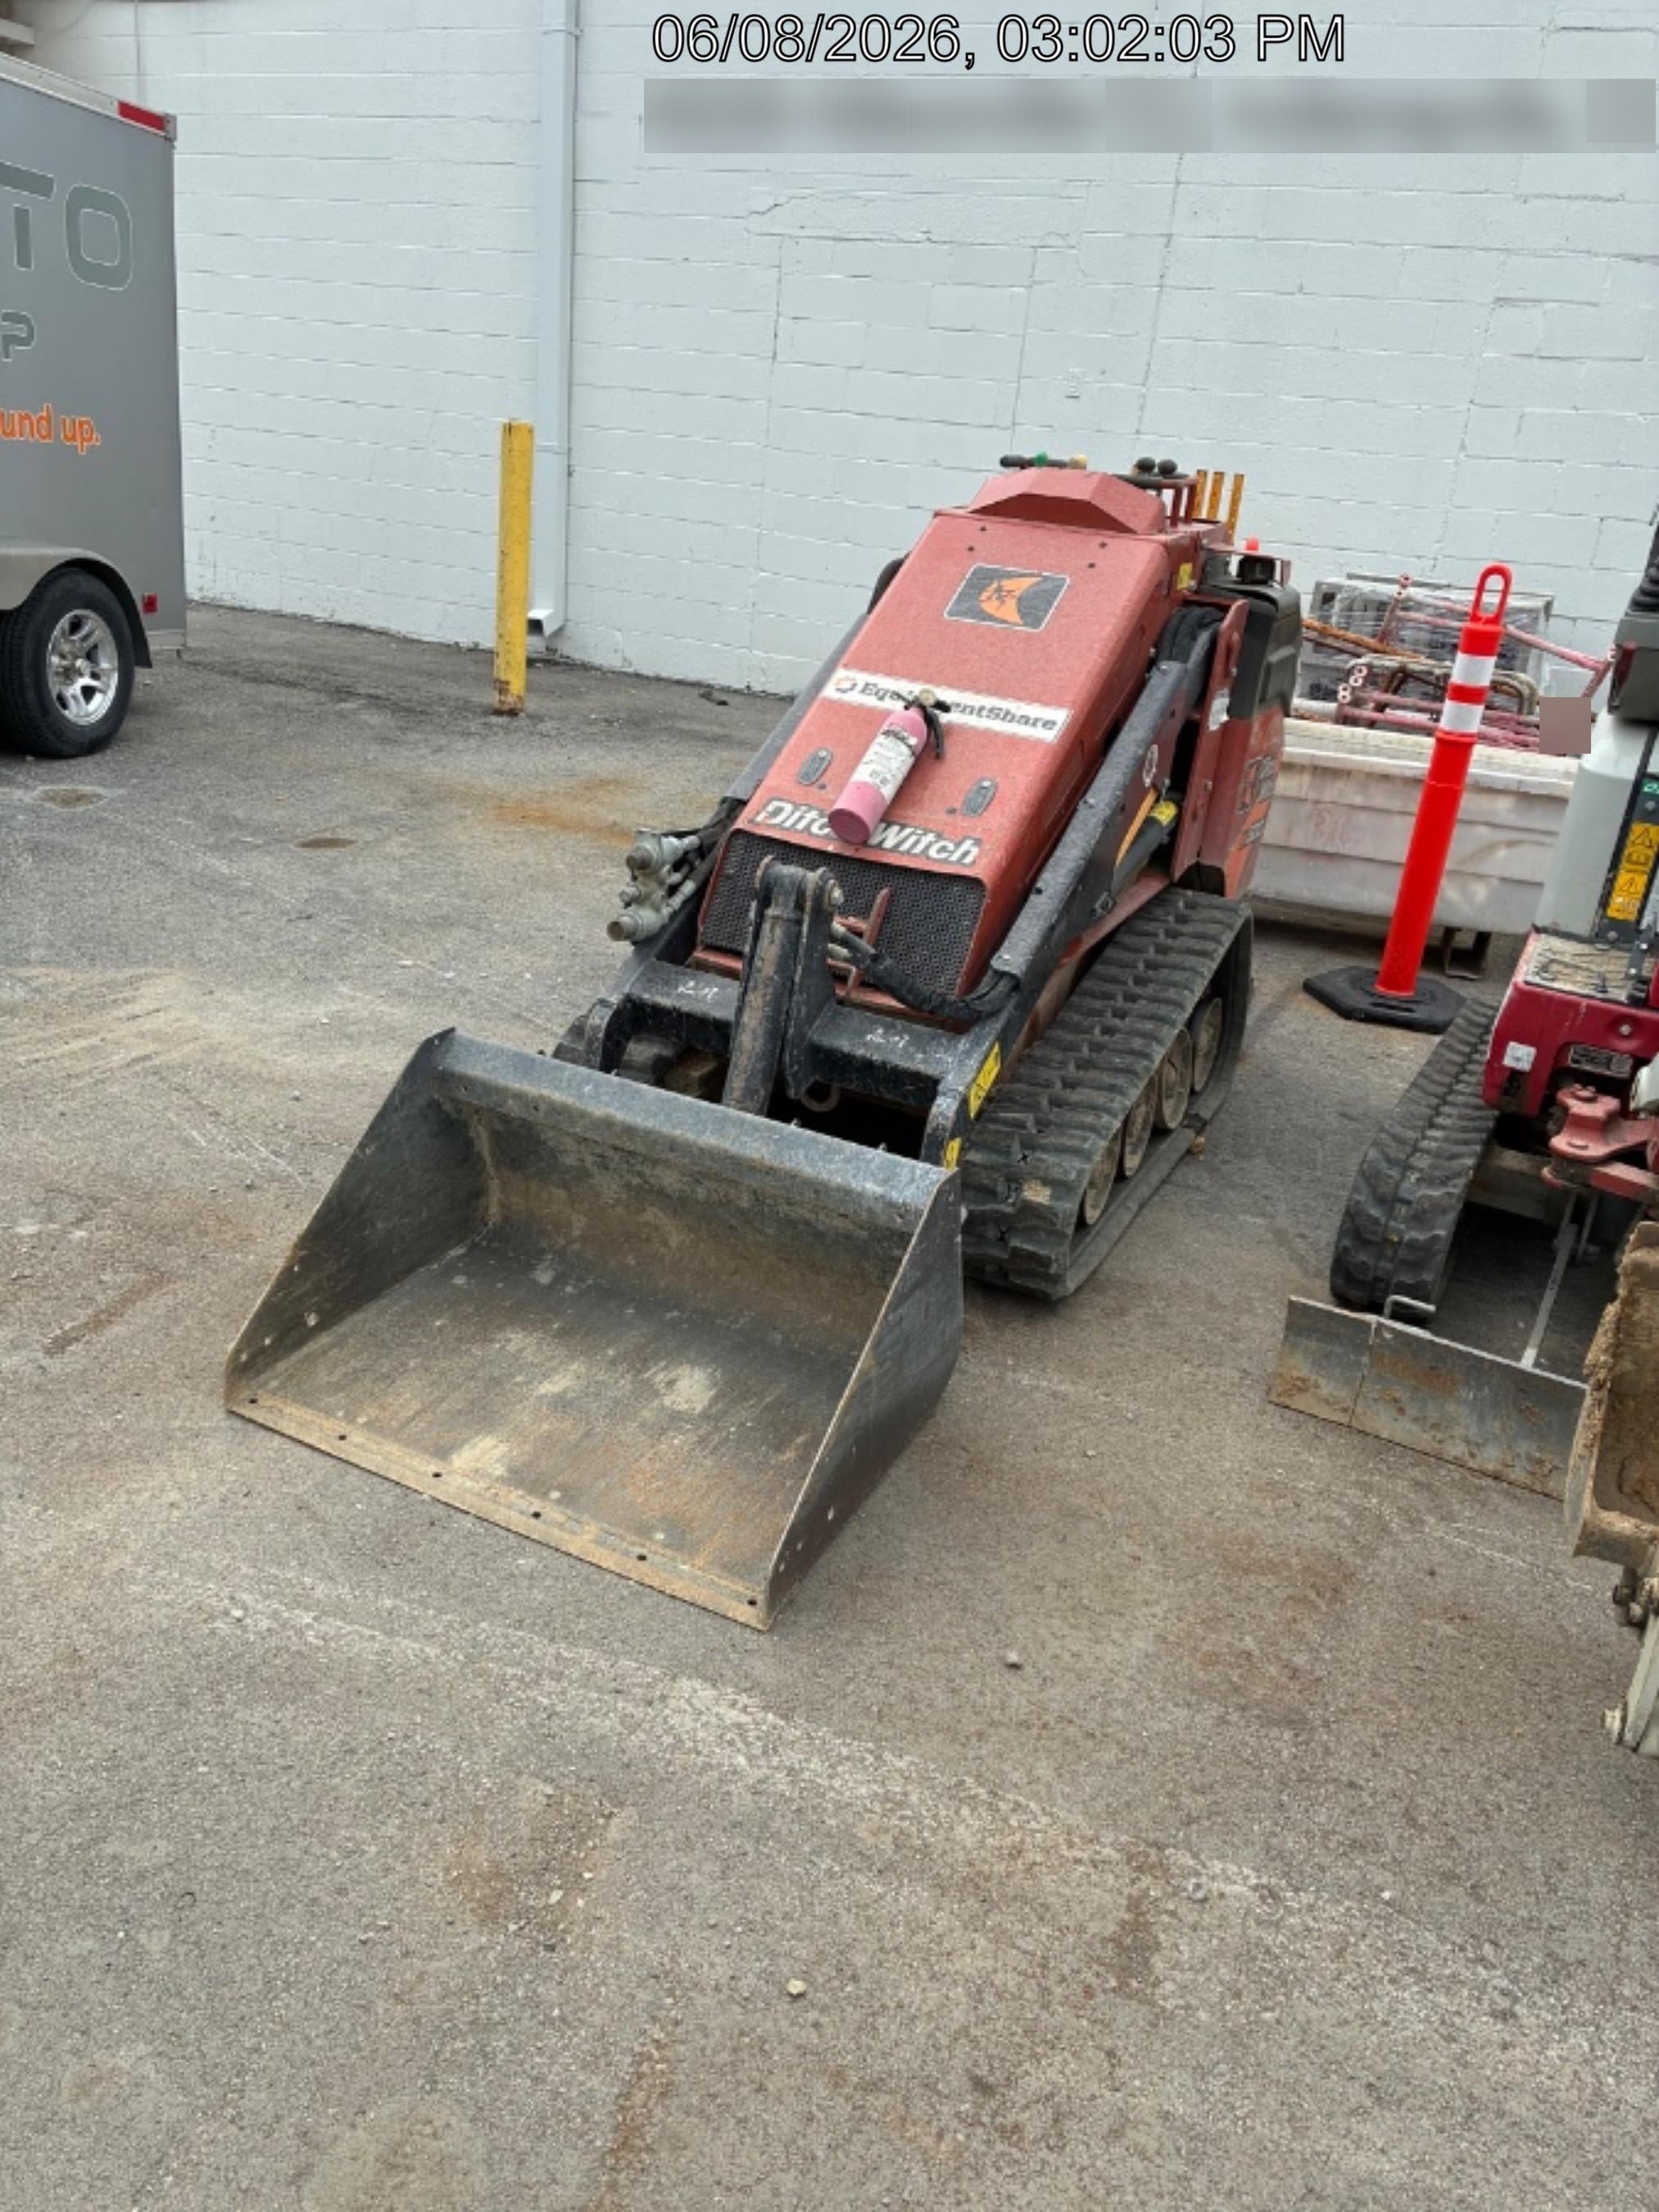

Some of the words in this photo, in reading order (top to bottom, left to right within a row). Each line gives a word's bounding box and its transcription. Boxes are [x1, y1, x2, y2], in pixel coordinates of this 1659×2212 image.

[60, 415, 102, 455] up.
[752, 797, 837, 841] Ditc
[866, 820, 982, 866] Witch
